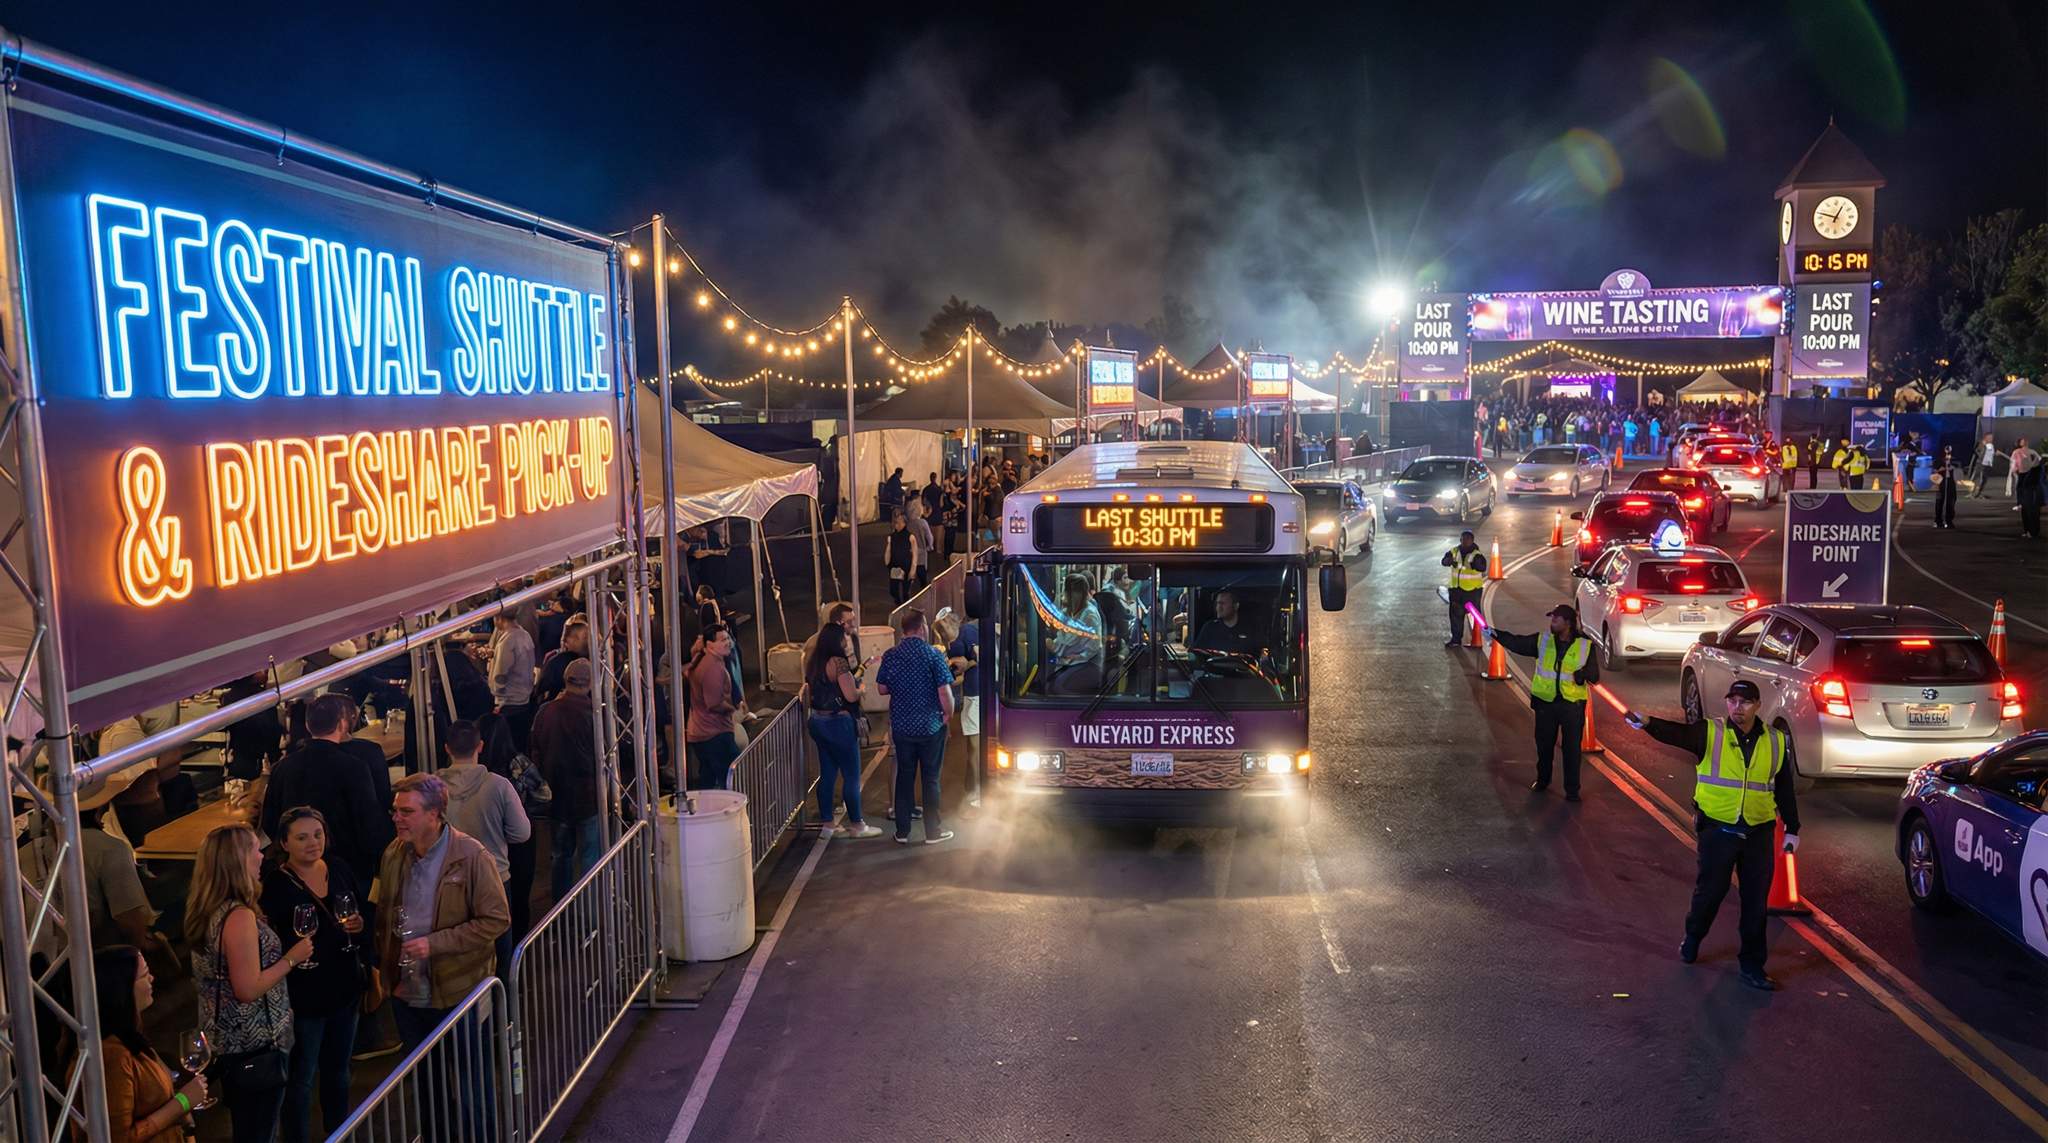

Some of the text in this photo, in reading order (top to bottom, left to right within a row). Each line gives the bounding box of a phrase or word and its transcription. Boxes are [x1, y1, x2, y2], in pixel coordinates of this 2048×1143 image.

[1846, 253, 1868, 269] PM
[86, 192, 611, 400] FESTIVAL SHUTTLE
[1812, 292, 1853, 311] LAST
[1416, 302, 1452, 319] LAST
[1543, 298, 1709, 325] WINE TASTING
[1413, 321, 1452, 338] POUR
[1809, 313, 1853, 332] POUR
[1407, 340, 1459, 356] 10:00 PM
[1802, 333, 1861, 350] 10:00 PM
[117, 417, 613, 608] & RIDESHARE PICK-UP
[1085, 508, 1223, 528] LAST SHUTTLE
[1112, 528, 1196, 546] 10:30 PM
[1792, 524, 1882, 542] RIDESHARE
[1812, 545, 1860, 562] POINT
[1071, 724, 1235, 745] VINEYARD EXPRESS
[1973, 834, 2003, 878] App
